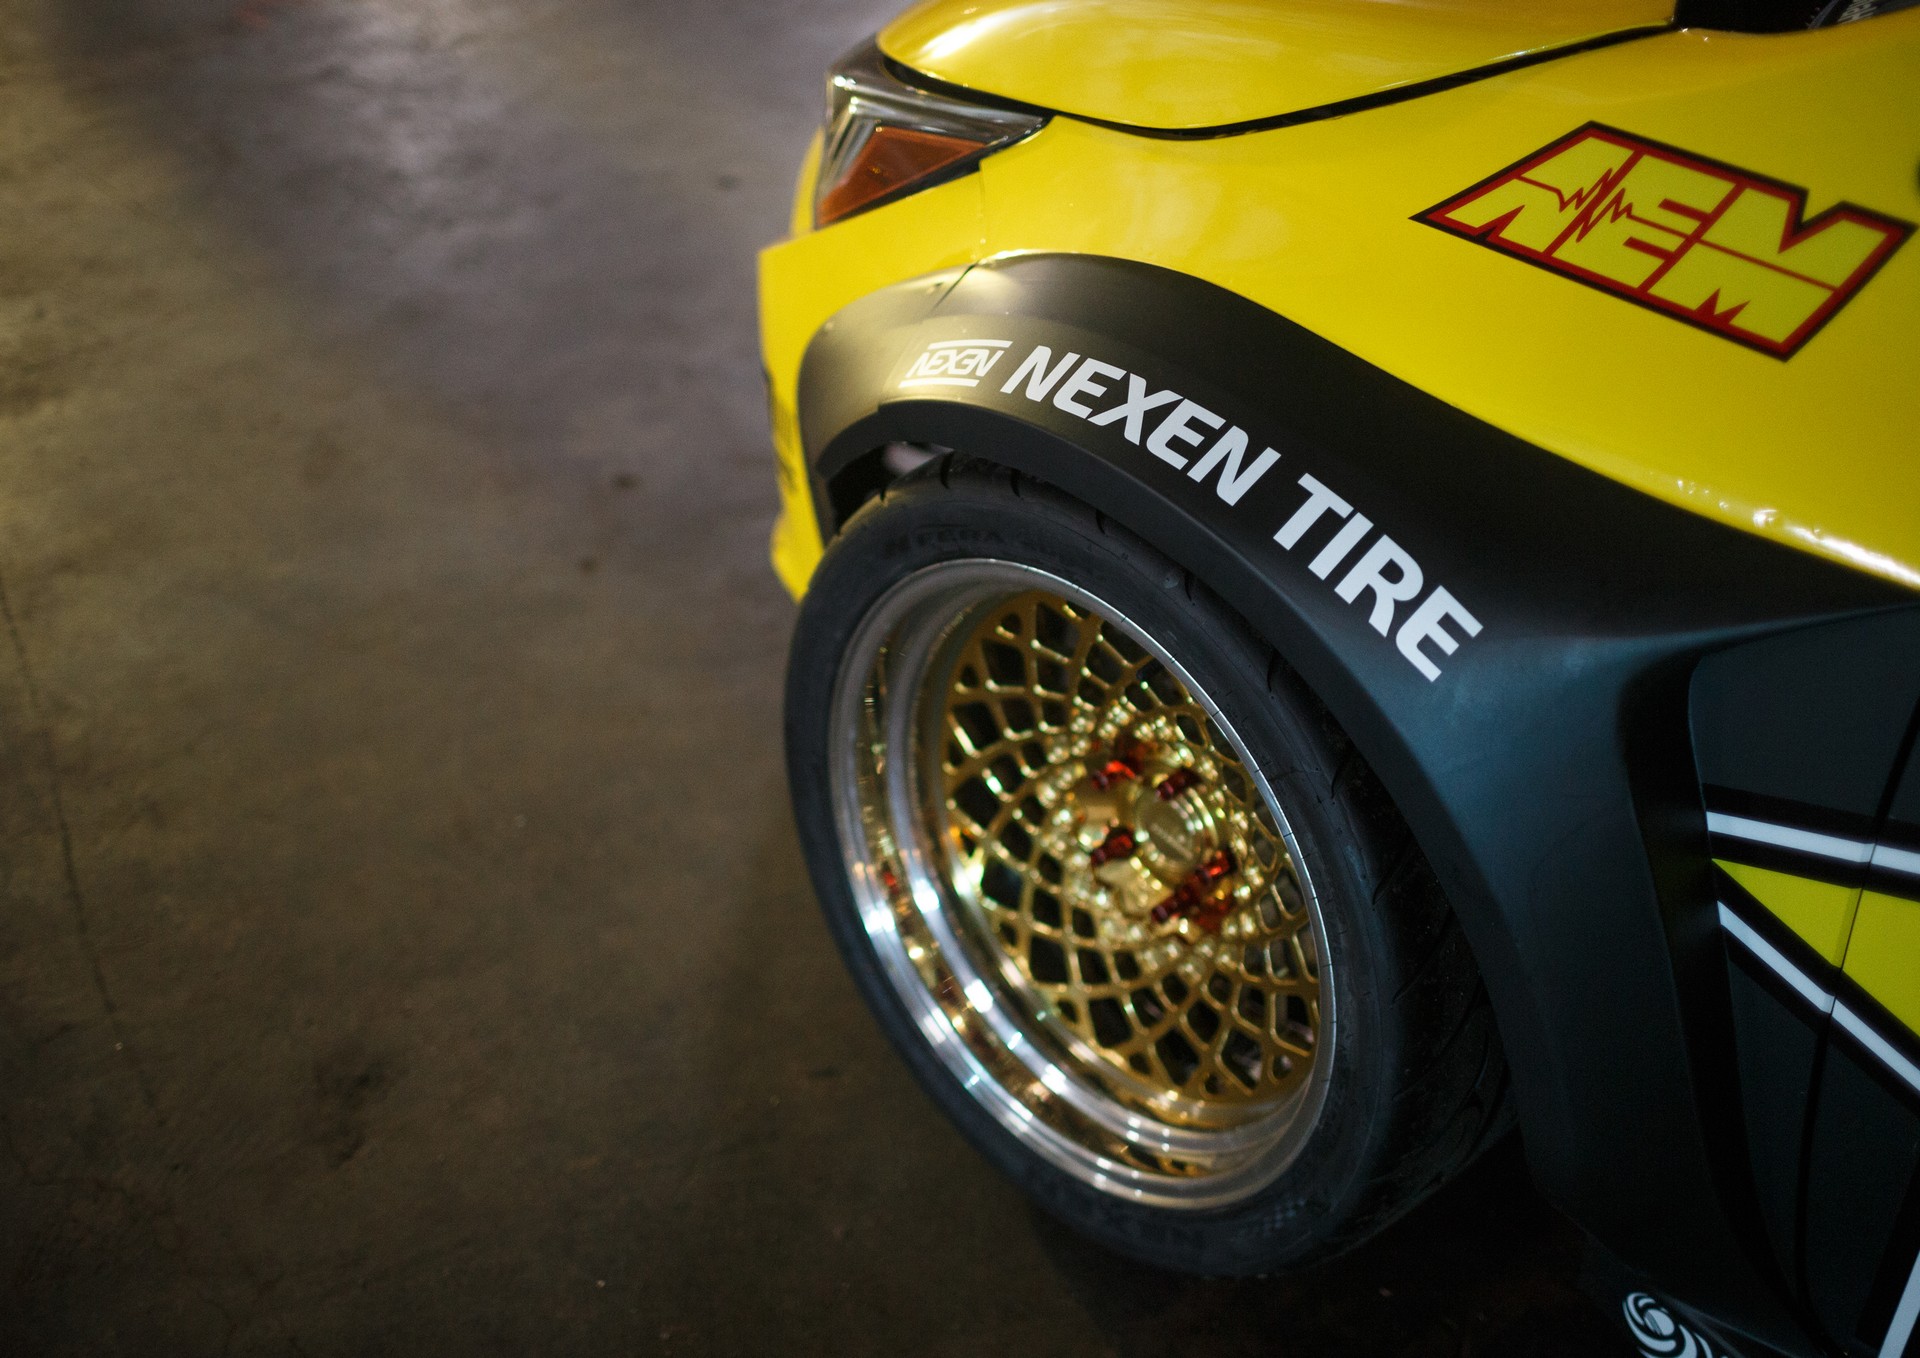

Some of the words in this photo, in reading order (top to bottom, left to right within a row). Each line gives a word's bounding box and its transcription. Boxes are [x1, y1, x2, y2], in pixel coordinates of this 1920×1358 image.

[1424, 127, 1907, 354] AEM
[904, 348, 1005, 379] NEXEN
[1000, 345, 1282, 507] NEXEN
[1273, 473, 1484, 683] TIRE
